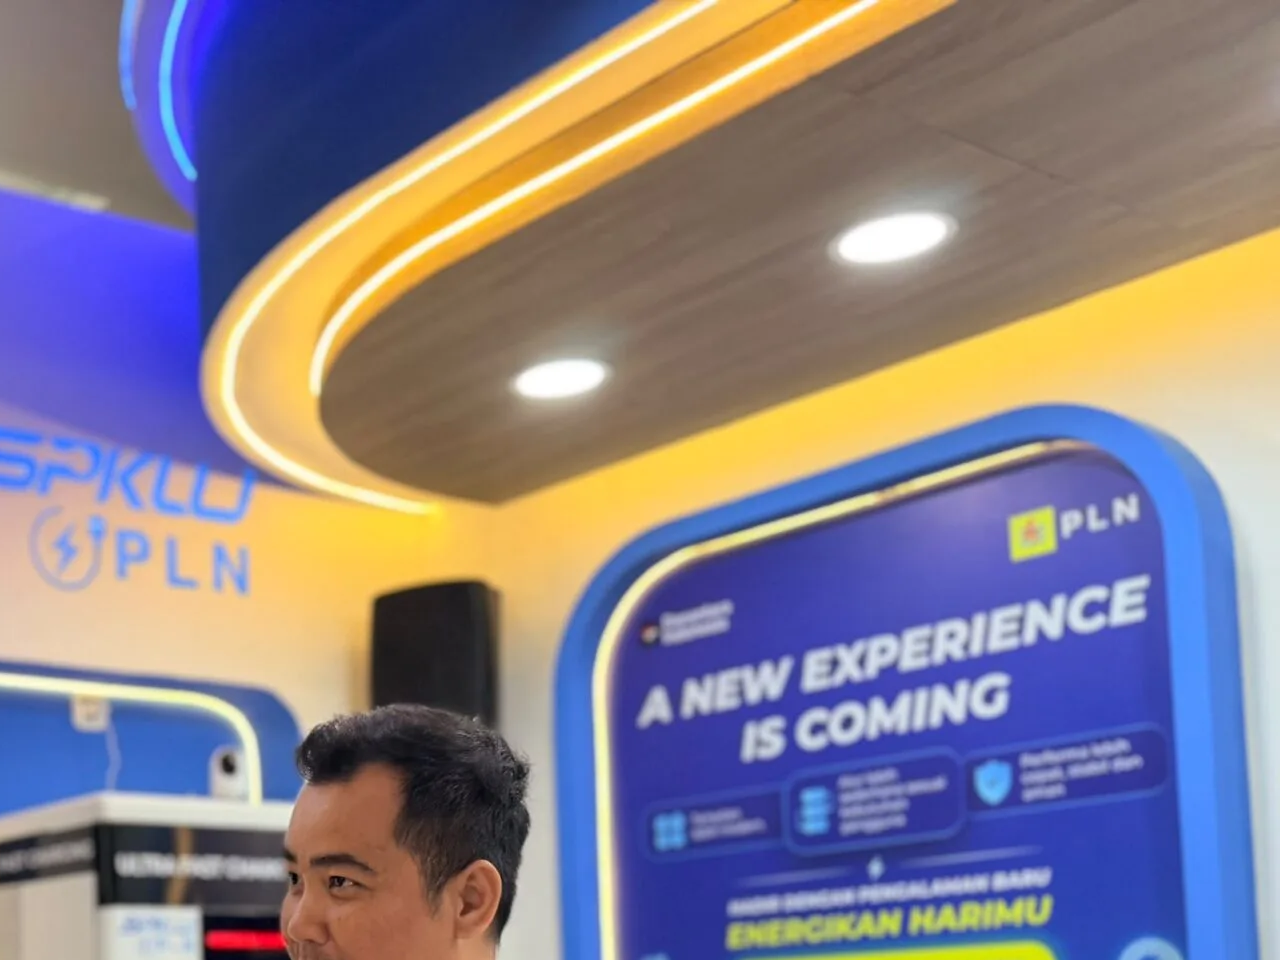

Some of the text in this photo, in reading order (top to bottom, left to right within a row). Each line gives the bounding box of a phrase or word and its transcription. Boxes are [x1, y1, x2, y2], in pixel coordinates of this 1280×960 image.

[1059, 494, 1141, 540] PLN
[114, 527, 251, 597] PLN
[636, 685, 674, 729] A
[679, 655, 793, 719] NEW
[799, 574, 1151, 694] EXPERIENCE
[740, 672, 1011, 763] IS COMING
[908, 893, 1054, 936] HARIMU
